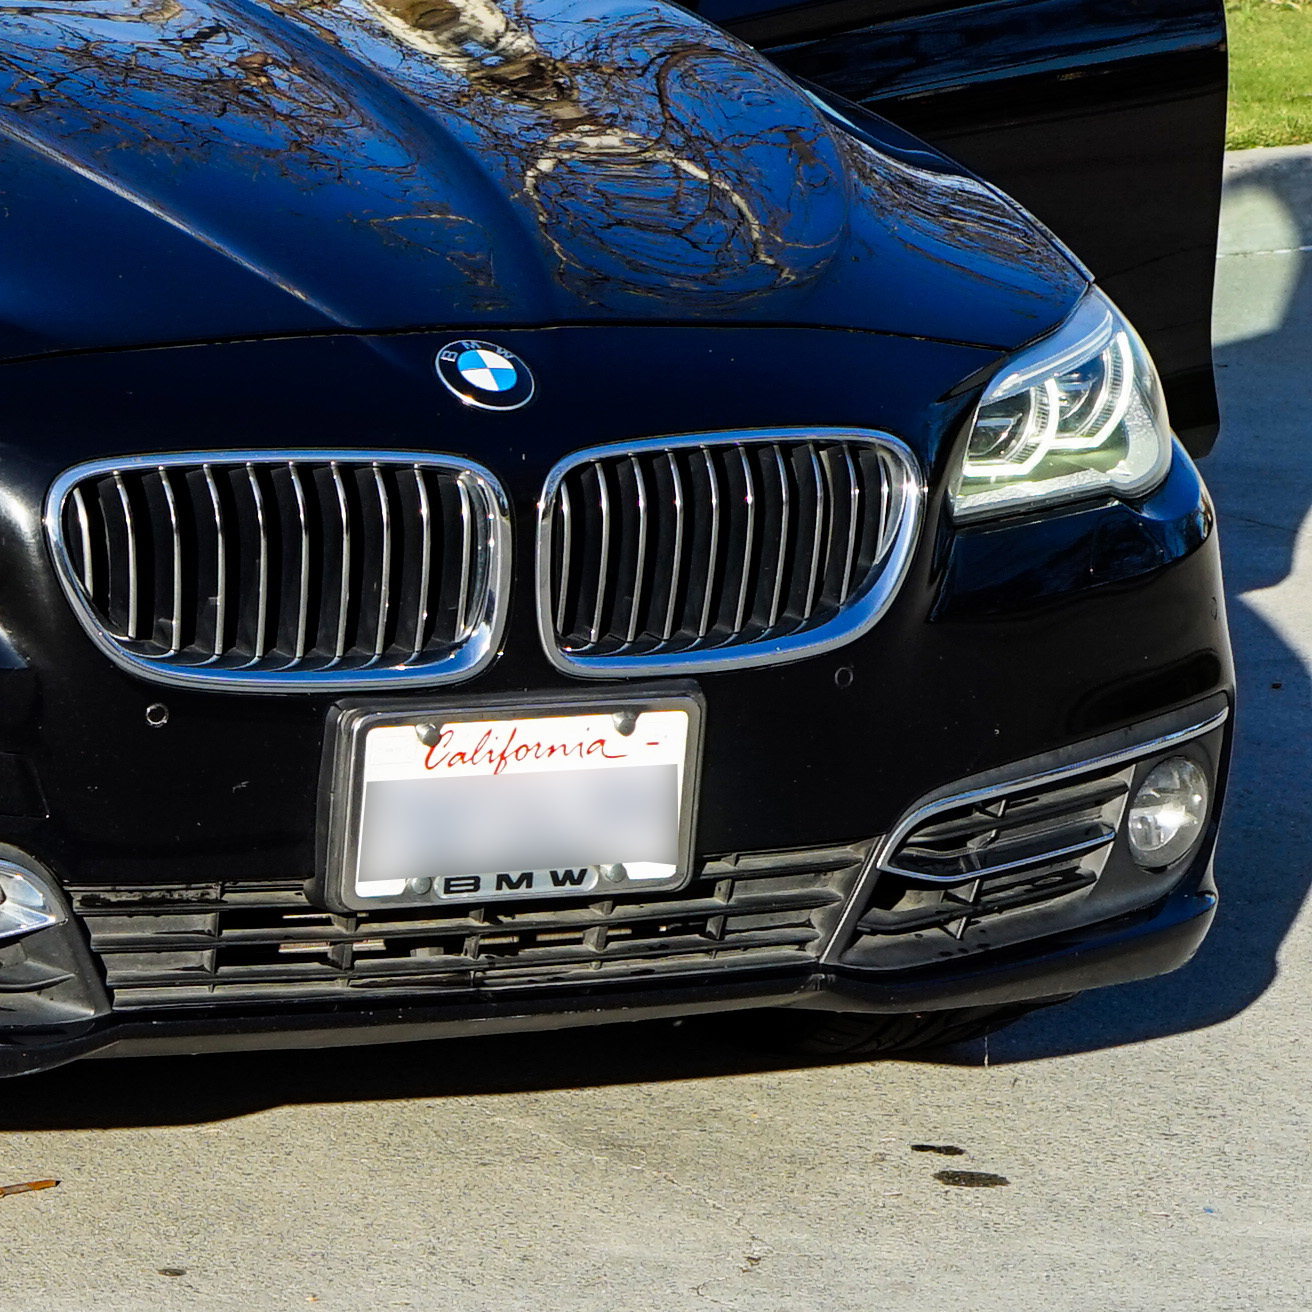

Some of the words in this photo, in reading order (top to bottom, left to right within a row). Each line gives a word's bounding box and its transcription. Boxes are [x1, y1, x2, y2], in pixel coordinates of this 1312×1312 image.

[440, 341, 515, 362] BMW
[425, 727, 628, 775] California
[443, 868, 589, 895] BMW
